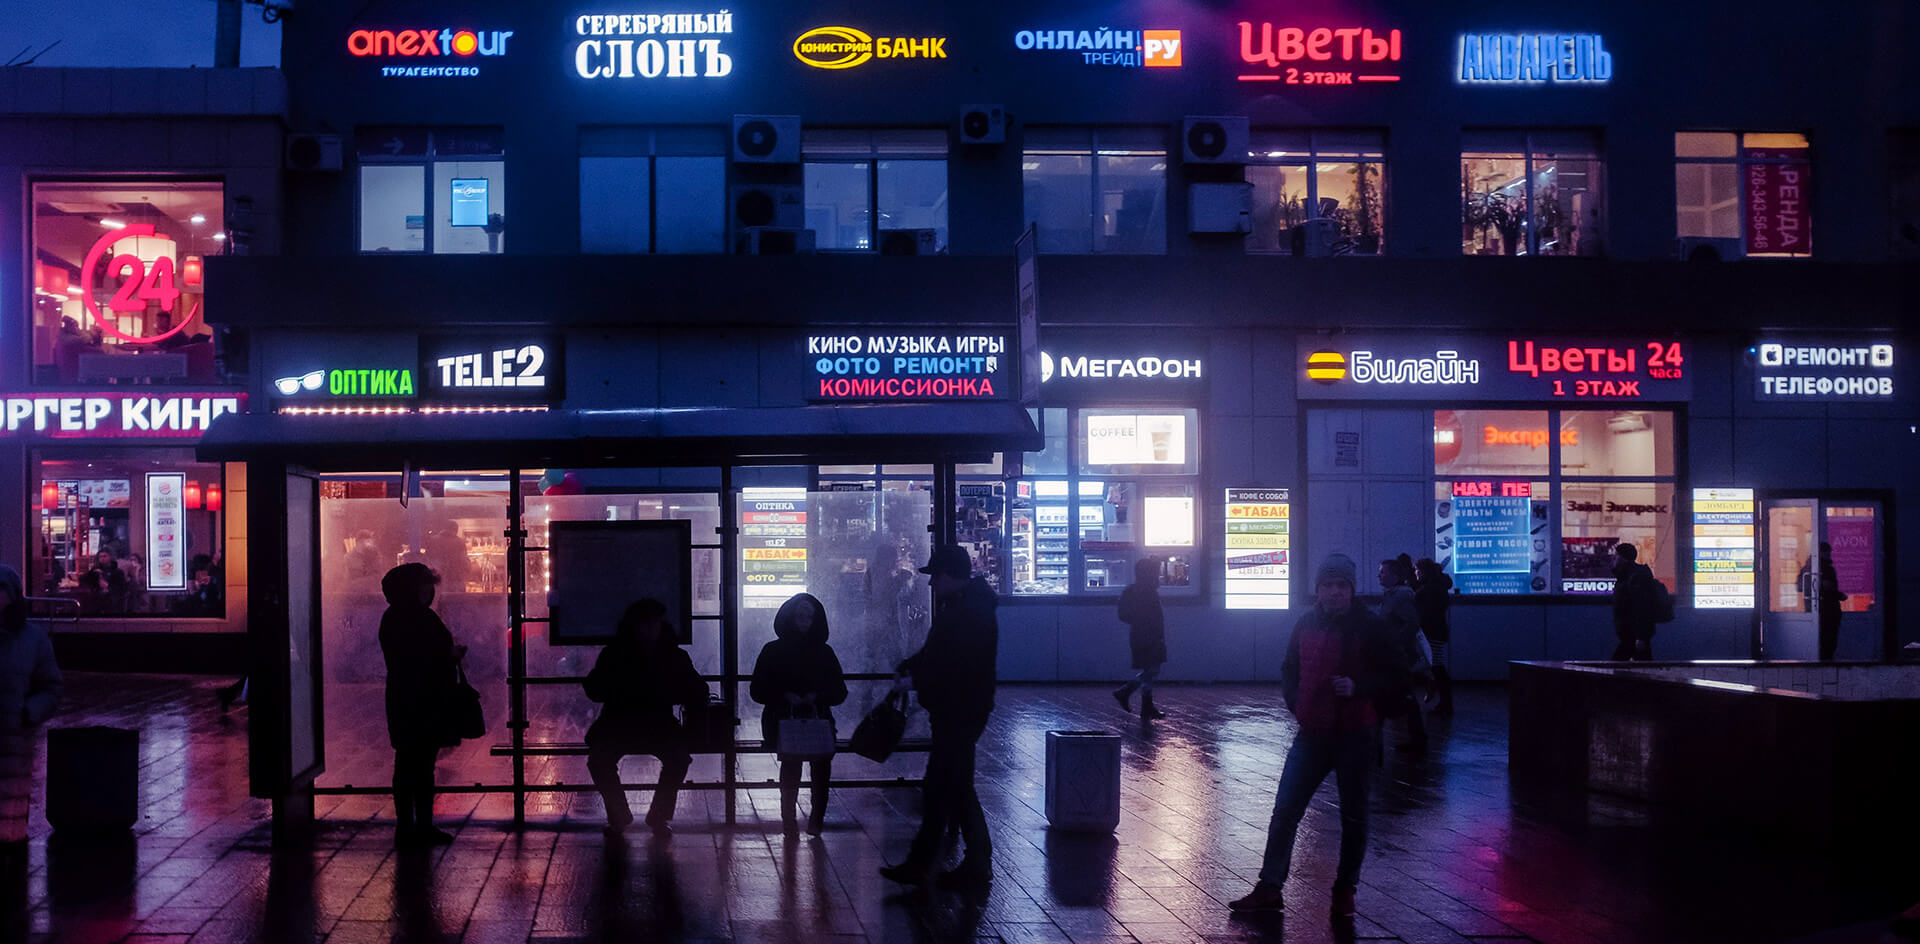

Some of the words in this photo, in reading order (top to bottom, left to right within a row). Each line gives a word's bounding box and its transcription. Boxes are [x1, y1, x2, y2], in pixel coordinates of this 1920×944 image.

[576, 9, 733, 36] СЕРЕБРЯНЫЙ
[347, 28, 514, 56] anextour
[1015, 26, 1133, 50] ОНЛАЙН
[1238, 21, 1401, 67] Цветы
[801, 43, 872, 53] ЮНИСТРИМ
[876, 37, 947, 58] БАНК
[575, 39, 733, 78] СЛОНЪ
[1082, 51, 1135, 67] ТРЕЙД
[1458, 34, 1611, 82] АКВАРЕЛЬ
[382, 67, 479, 77] ТУРАГЕНТСТВО
[1286, 68, 1299, 84] 2
[1303, 71, 1353, 84] этаж
[107, 253, 180, 311] 24
[808, 336, 862, 353] КИНО
[867, 336, 950, 353] МУЗЫКА
[956, 336, 1004, 353] ИГРЫ
[1508, 340, 1635, 377] Цветы
[1647, 342, 1683, 367] 24
[1784, 347, 1869, 365] РЕМОНТ
[437, 345, 545, 387] TELE2
[815, 357, 880, 374] ФОТО
[893, 357, 985, 374] РЕМОНТ
[1351, 350, 1479, 384] Билайн
[1649, 368, 1682, 378] часа
[329, 369, 413, 395] ОПТИКА
[820, 378, 995, 396] КОМИССИОНКА
[1553, 380, 1565, 396] 1
[1575, 380, 1640, 396] ЭТАЖ
[1761, 376, 1893, 395] ТЕЛЕФОНОВ
[0, 398, 111, 430] РГЕР
[1090, 427, 1135, 438] COFFEE
[1453, 482, 1492, 497] НАЯ
[755, 502, 795, 510] ОПТИКА
[1242, 506, 1287, 517] ТАБАК
[1833, 536, 1868, 547] AVON
[747, 550, 790, 559] ТАБАК
[746, 574, 776, 583] ФОТО
